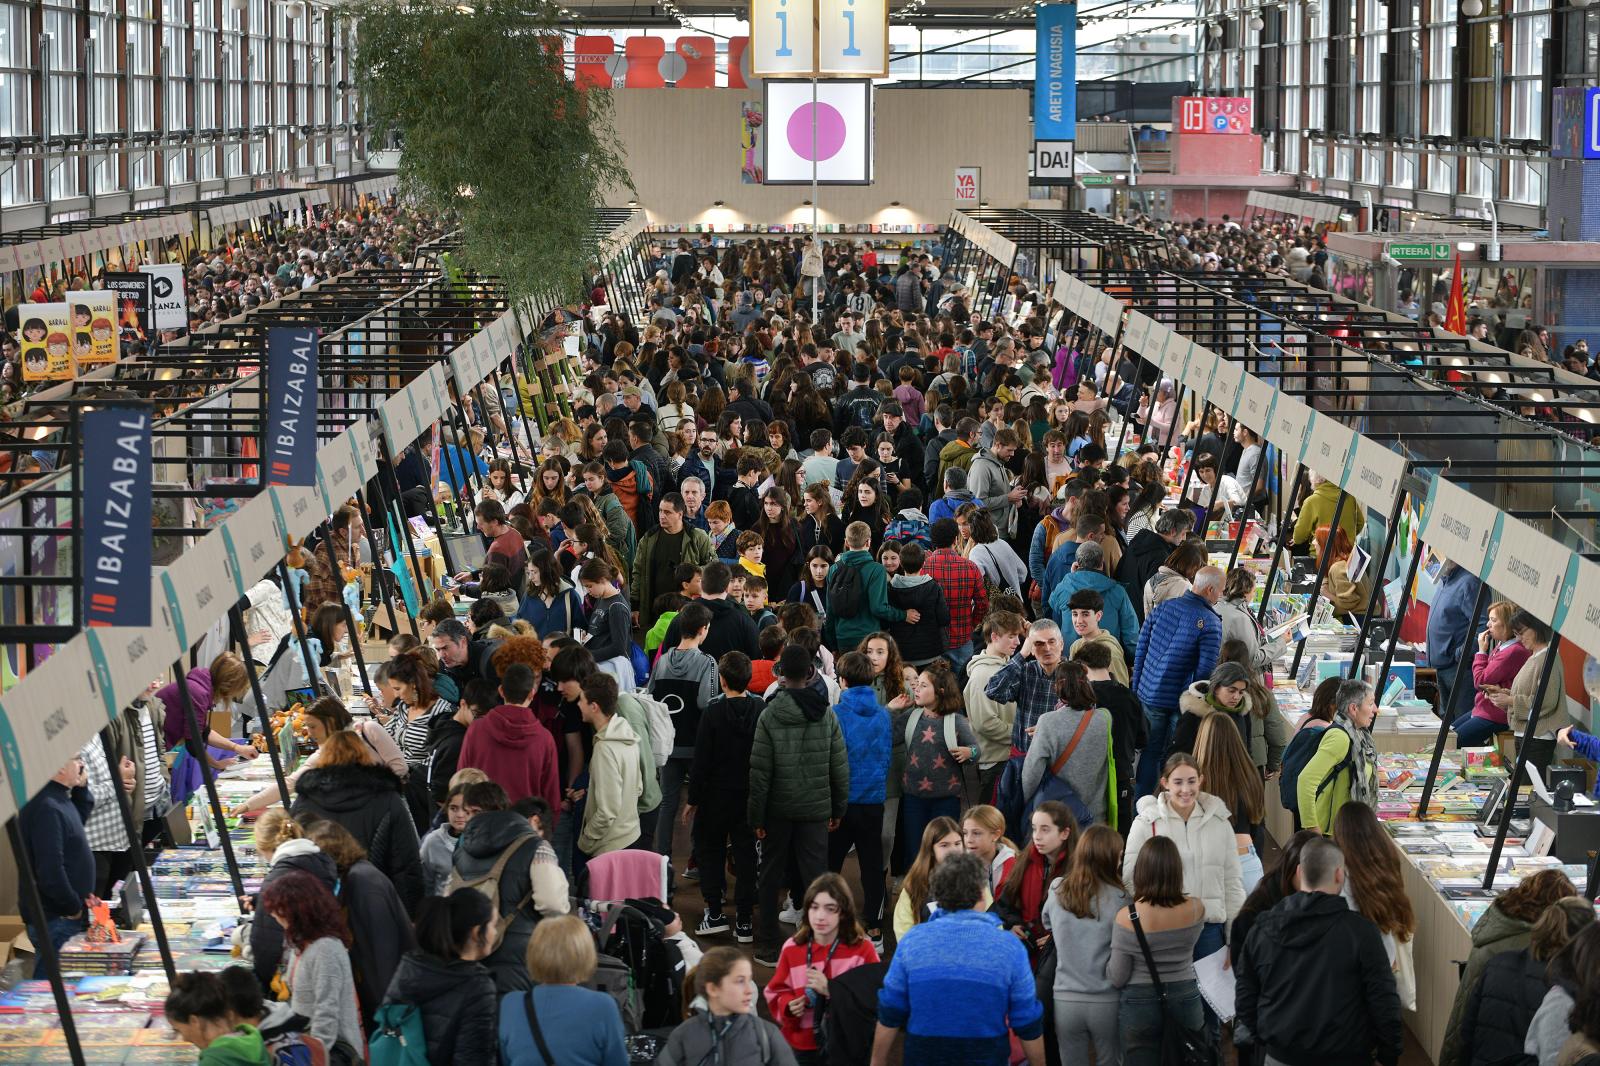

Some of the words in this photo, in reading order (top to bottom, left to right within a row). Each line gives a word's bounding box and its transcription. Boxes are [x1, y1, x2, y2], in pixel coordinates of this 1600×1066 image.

[1049, 24, 1064, 77] NAGUSIA
[1049, 80, 1063, 122] ARETO
[1040, 150, 1069, 169] DA!
[956, 187, 975, 199] NIZ
[957, 175, 974, 187] YA
[1391, 248, 1430, 256] IRTEERA
[276, 331, 313, 456] IBAIZABAL
[95, 414, 146, 585] IBAIZABAL
